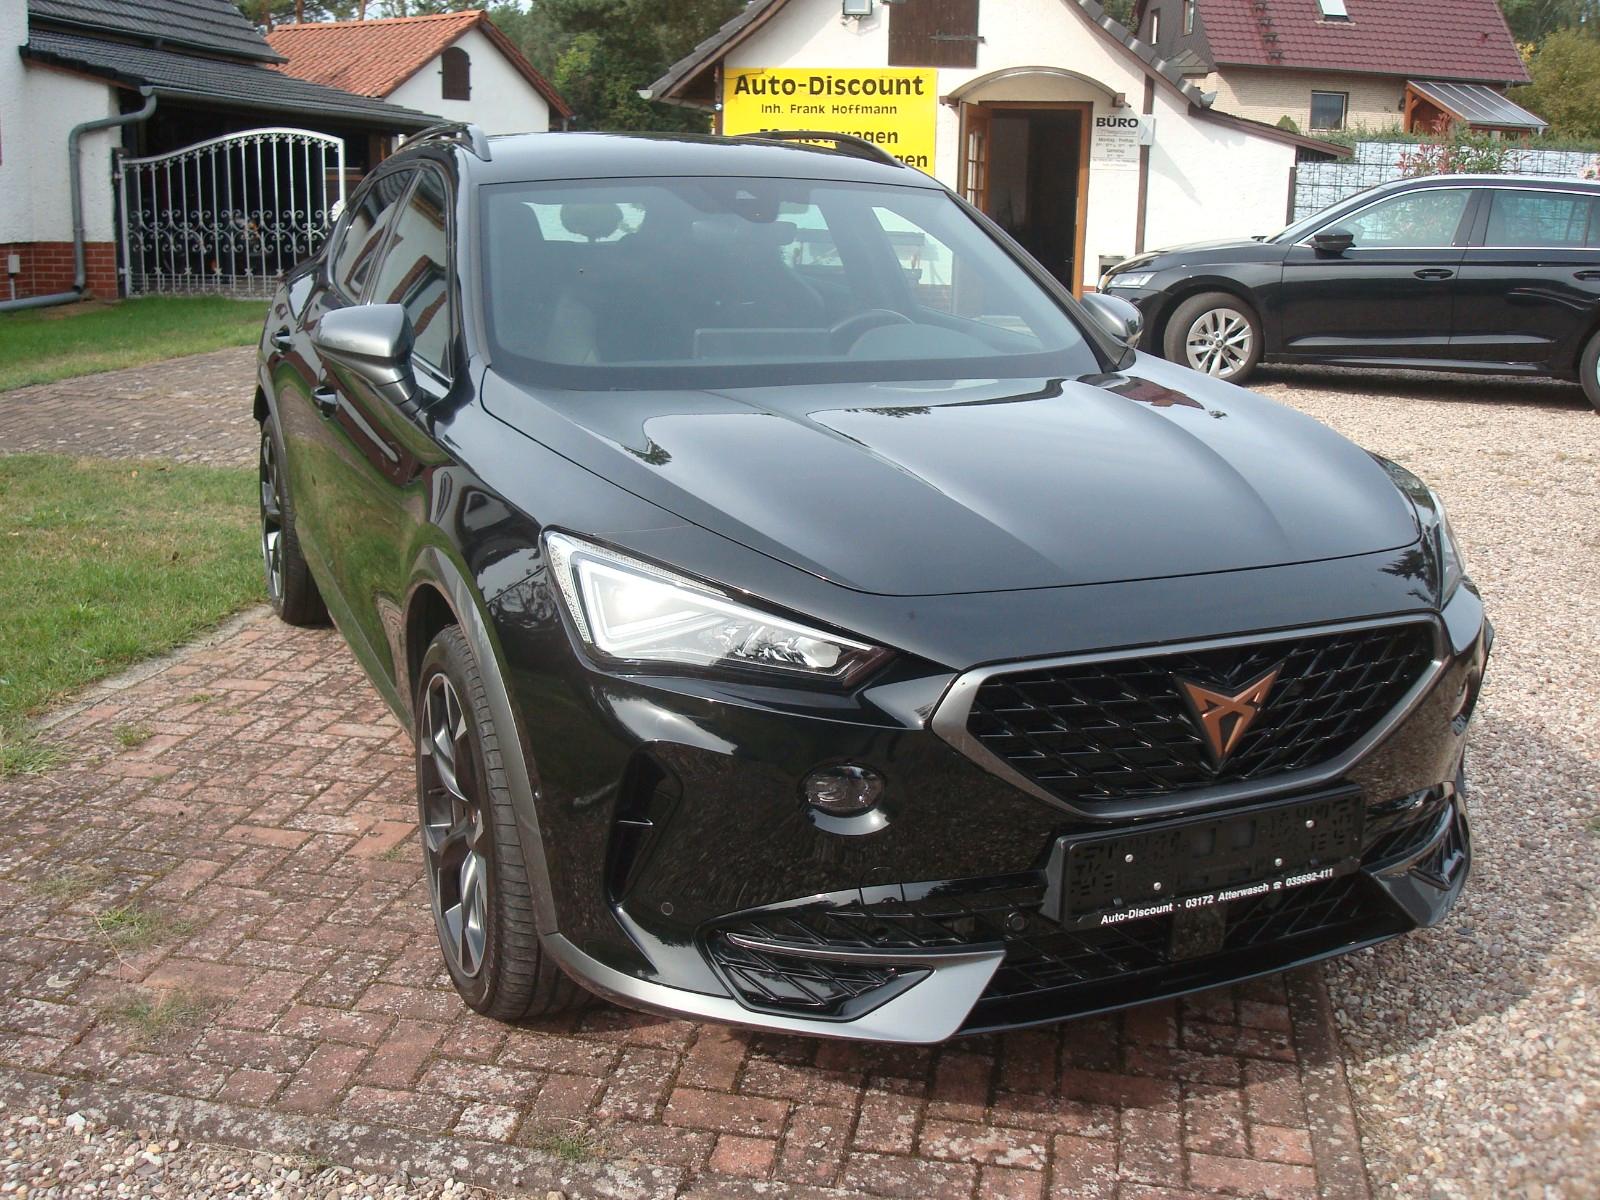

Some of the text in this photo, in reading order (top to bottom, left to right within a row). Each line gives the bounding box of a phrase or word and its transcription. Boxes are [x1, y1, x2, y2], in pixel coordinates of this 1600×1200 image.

[735, 75, 924, 96] Auto-Discount
[761, 104, 898, 115] Inh. Frank Hoffmann
[1096, 115, 1138, 127] BÜRO
[1100, 868, 1334, 925] Auto-Discount 03172 Atterwasch 035692-411
